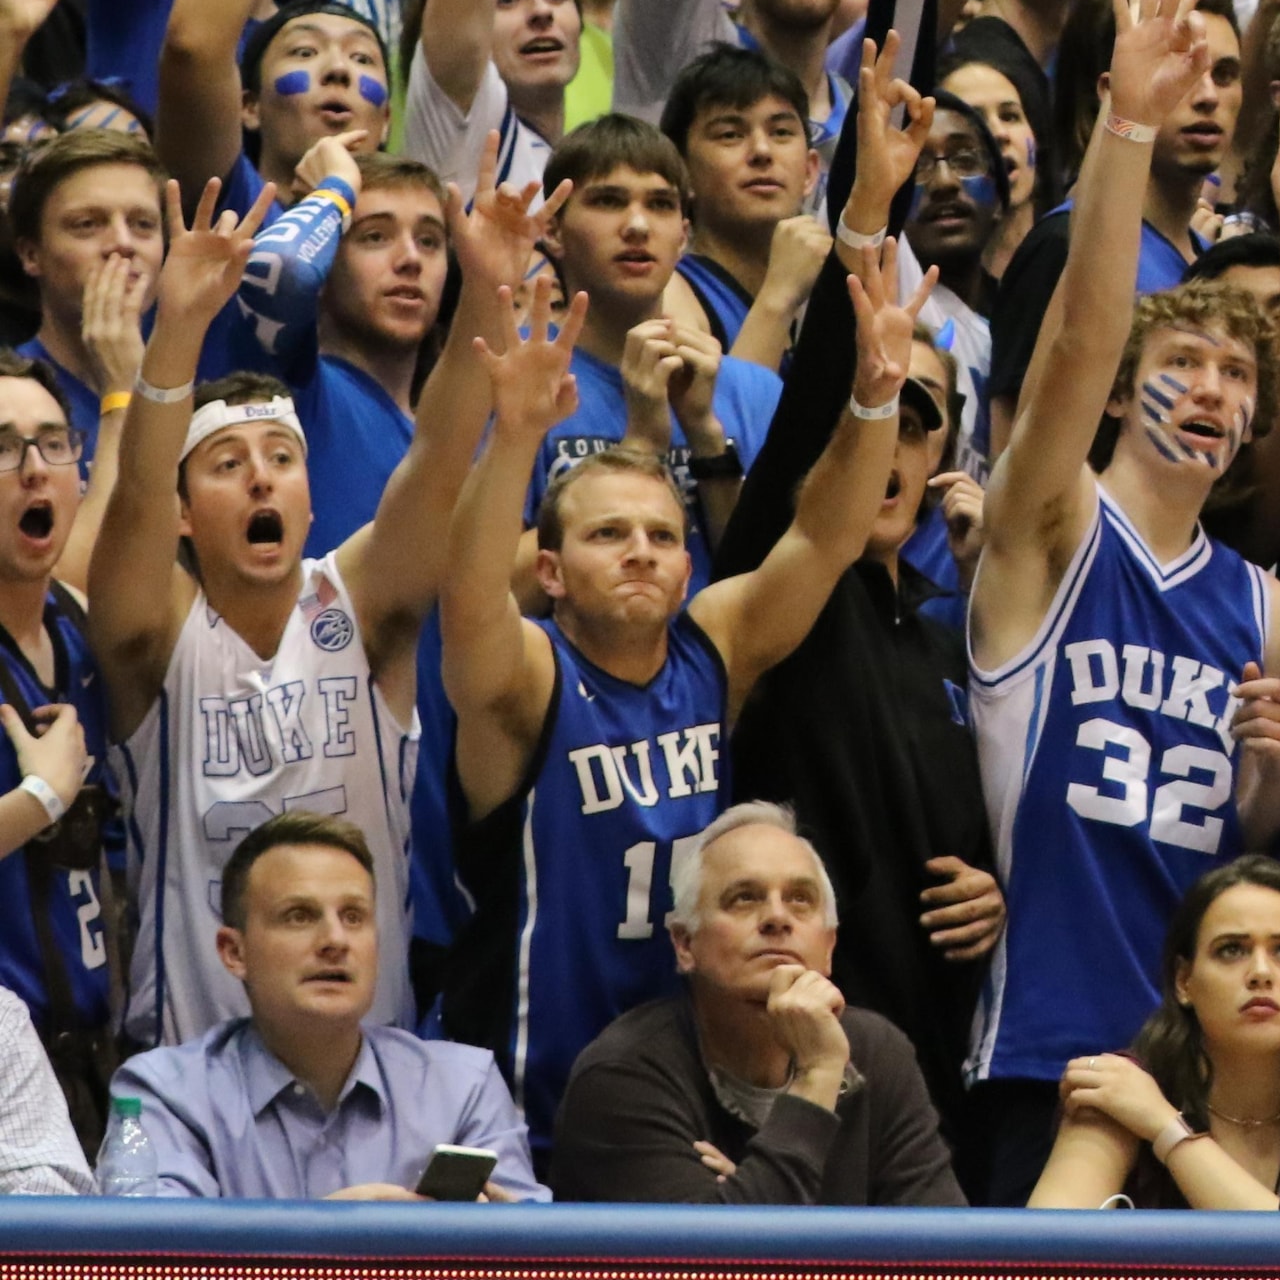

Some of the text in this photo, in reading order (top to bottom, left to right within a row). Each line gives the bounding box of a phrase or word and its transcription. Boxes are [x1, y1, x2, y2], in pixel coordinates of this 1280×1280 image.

[200, 676, 361, 778] DUKE
[569, 723, 720, 815] DUKE
[1067, 717, 1233, 855] 32
